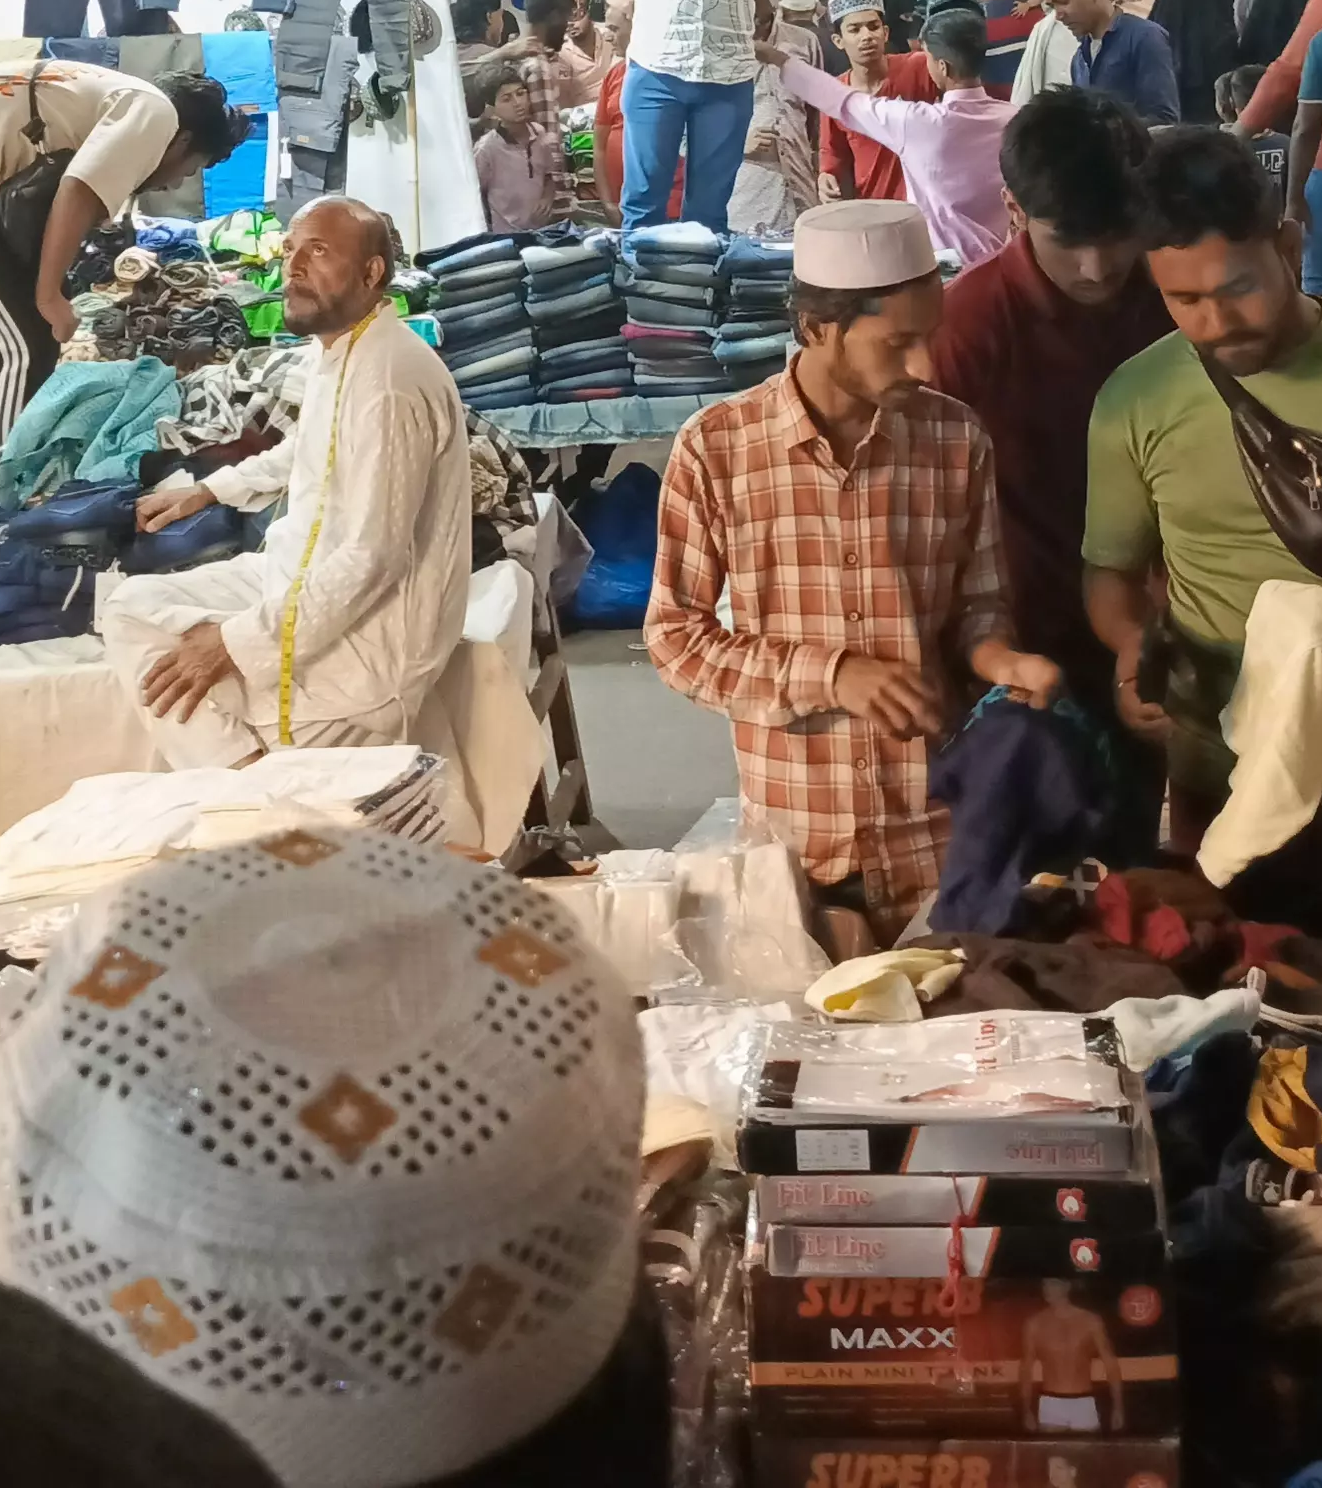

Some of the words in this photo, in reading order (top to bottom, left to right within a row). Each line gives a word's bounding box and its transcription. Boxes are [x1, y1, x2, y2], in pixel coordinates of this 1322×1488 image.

[777, 1180, 814, 1208] Fit
[830, 1326, 957, 1350] MAXX
[783, 1366, 853, 1380] PLAIN
[863, 1366, 915, 1379] MINI
